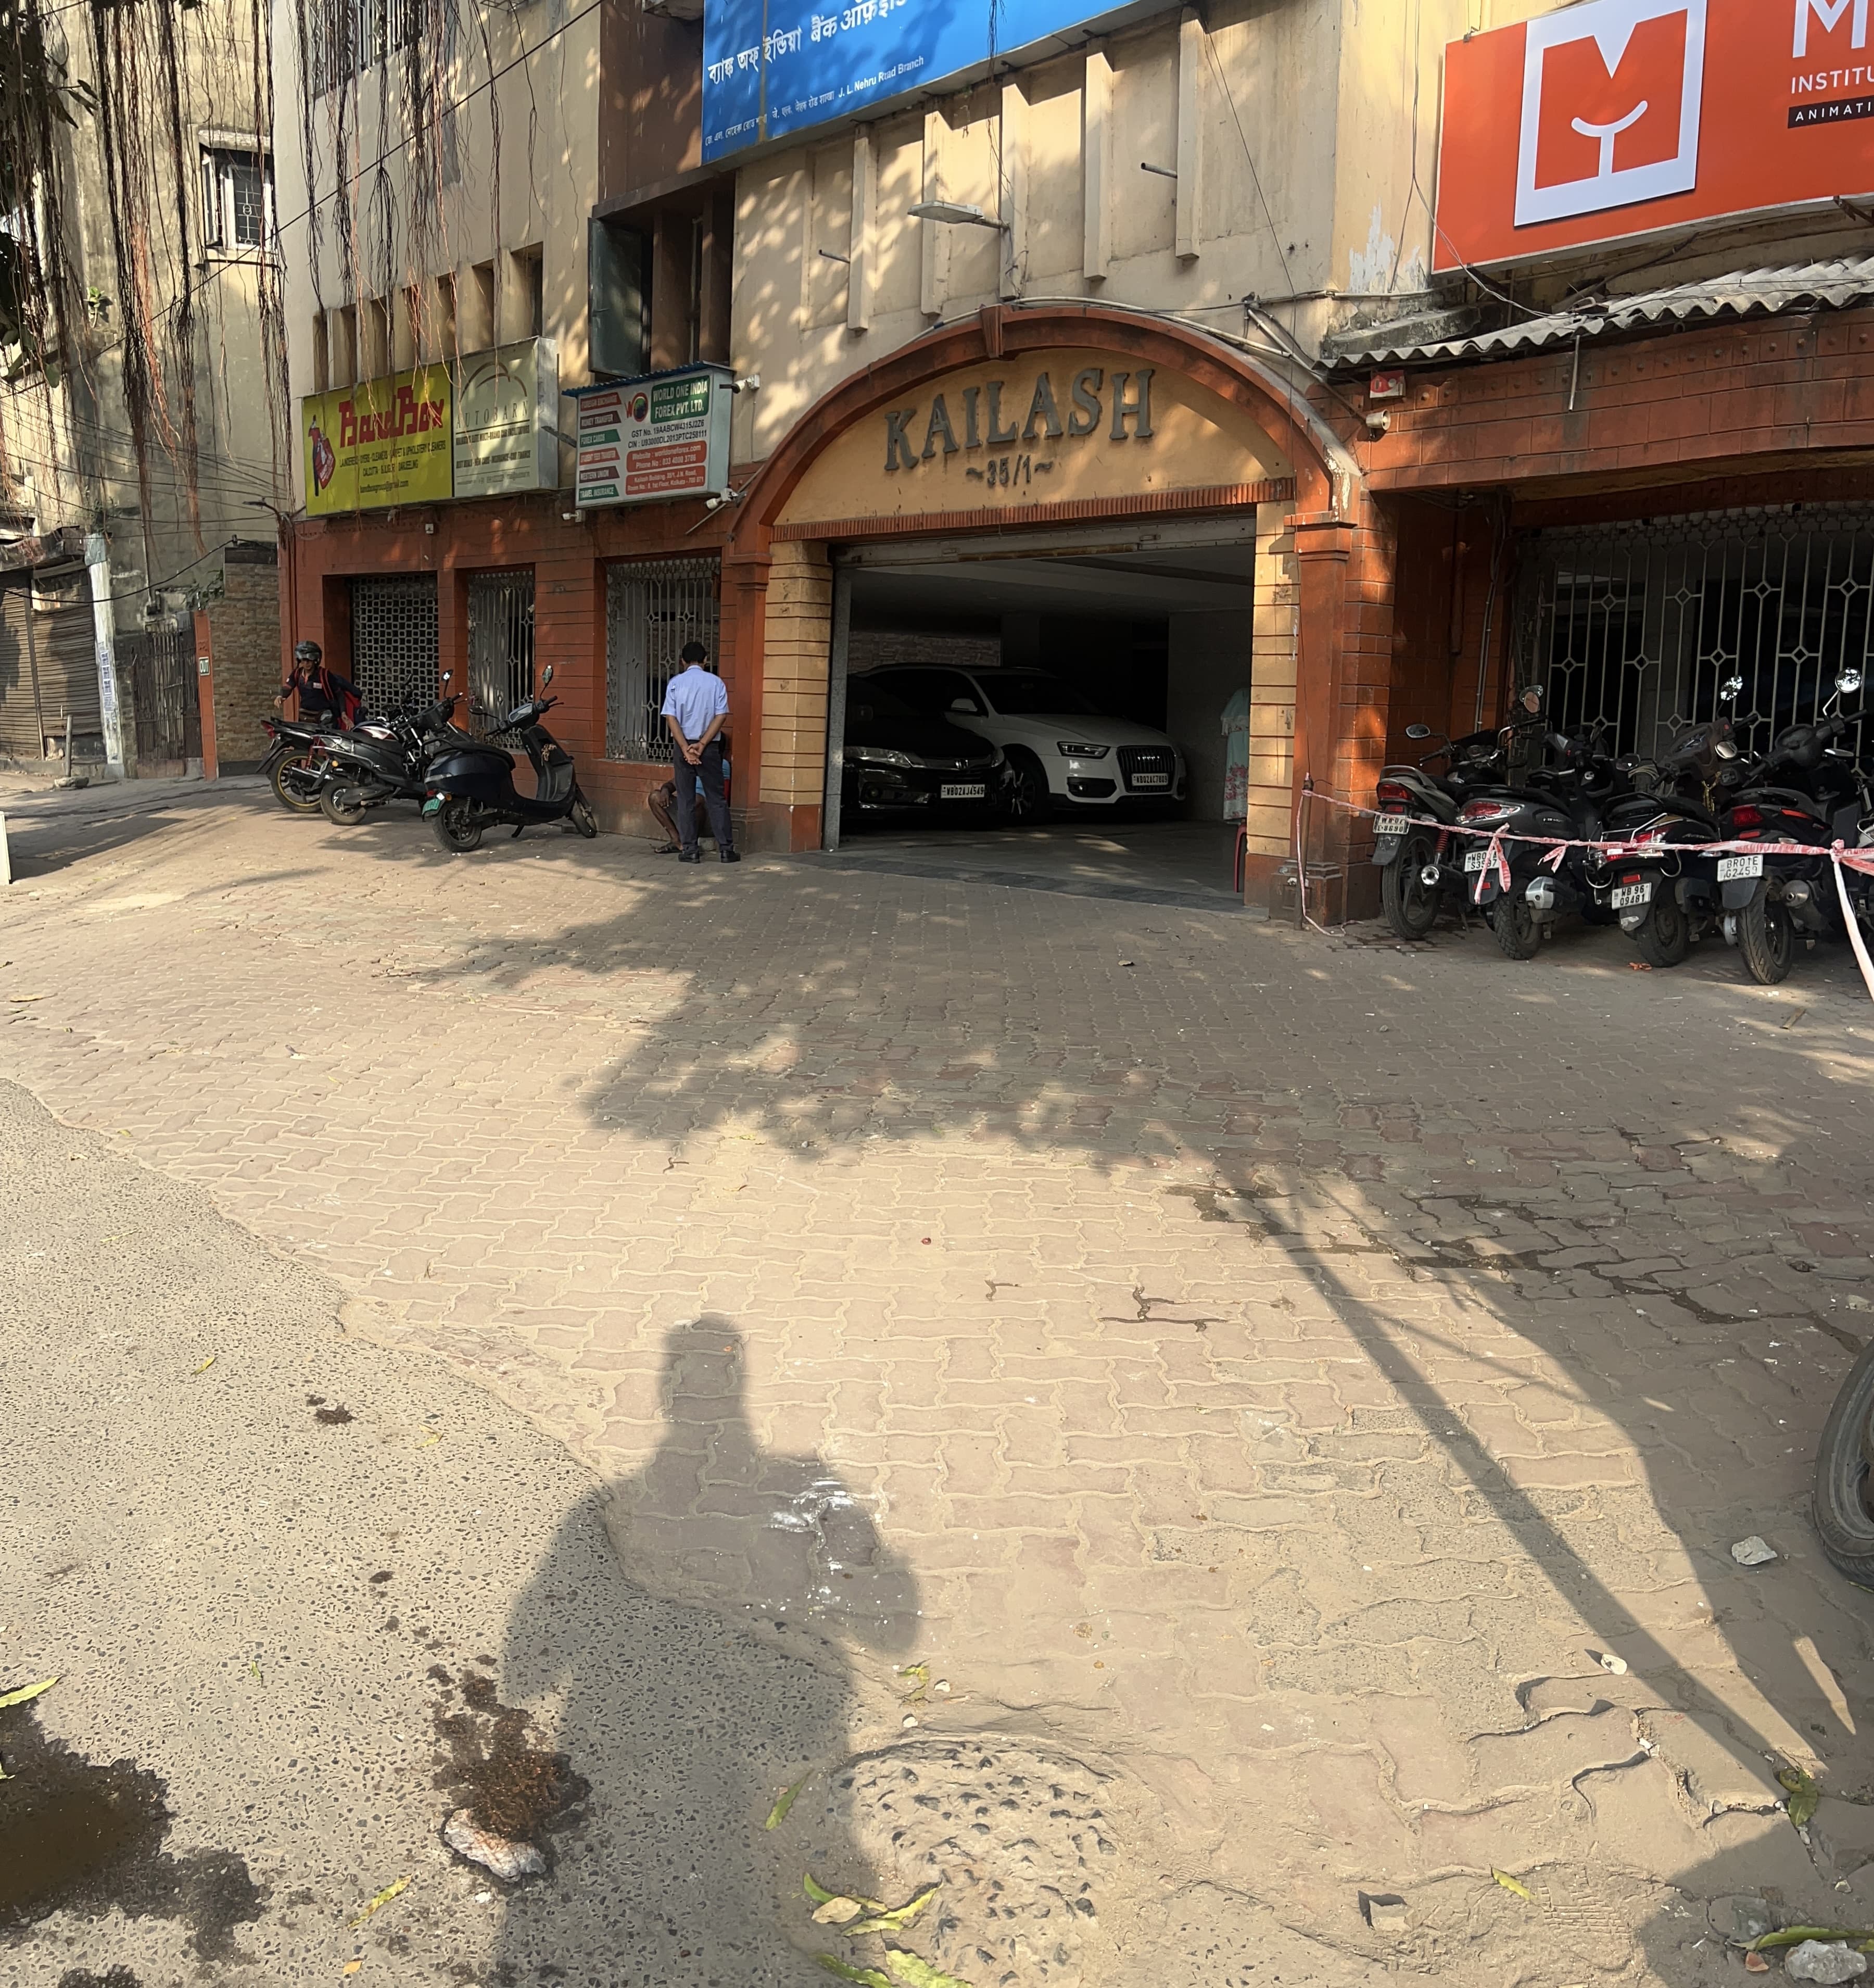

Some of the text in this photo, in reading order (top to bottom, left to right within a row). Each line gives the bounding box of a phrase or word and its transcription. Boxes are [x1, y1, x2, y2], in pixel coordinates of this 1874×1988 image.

[854, 77, 876, 91] Nehru
[898, 55, 923, 74] Branch
[1795, 102, 1871, 121] ANIMATI
[653, 381, 708, 402] WORLD ONE INDIA
[456, 400, 528, 429] AUTOBARN
[655, 399, 704, 419] FOREX PVT. LTD.
[884, 368, 1155, 471] KAILASH
[631, 429, 642, 438] GST
[1622, 885, 1644, 896] WB 96
